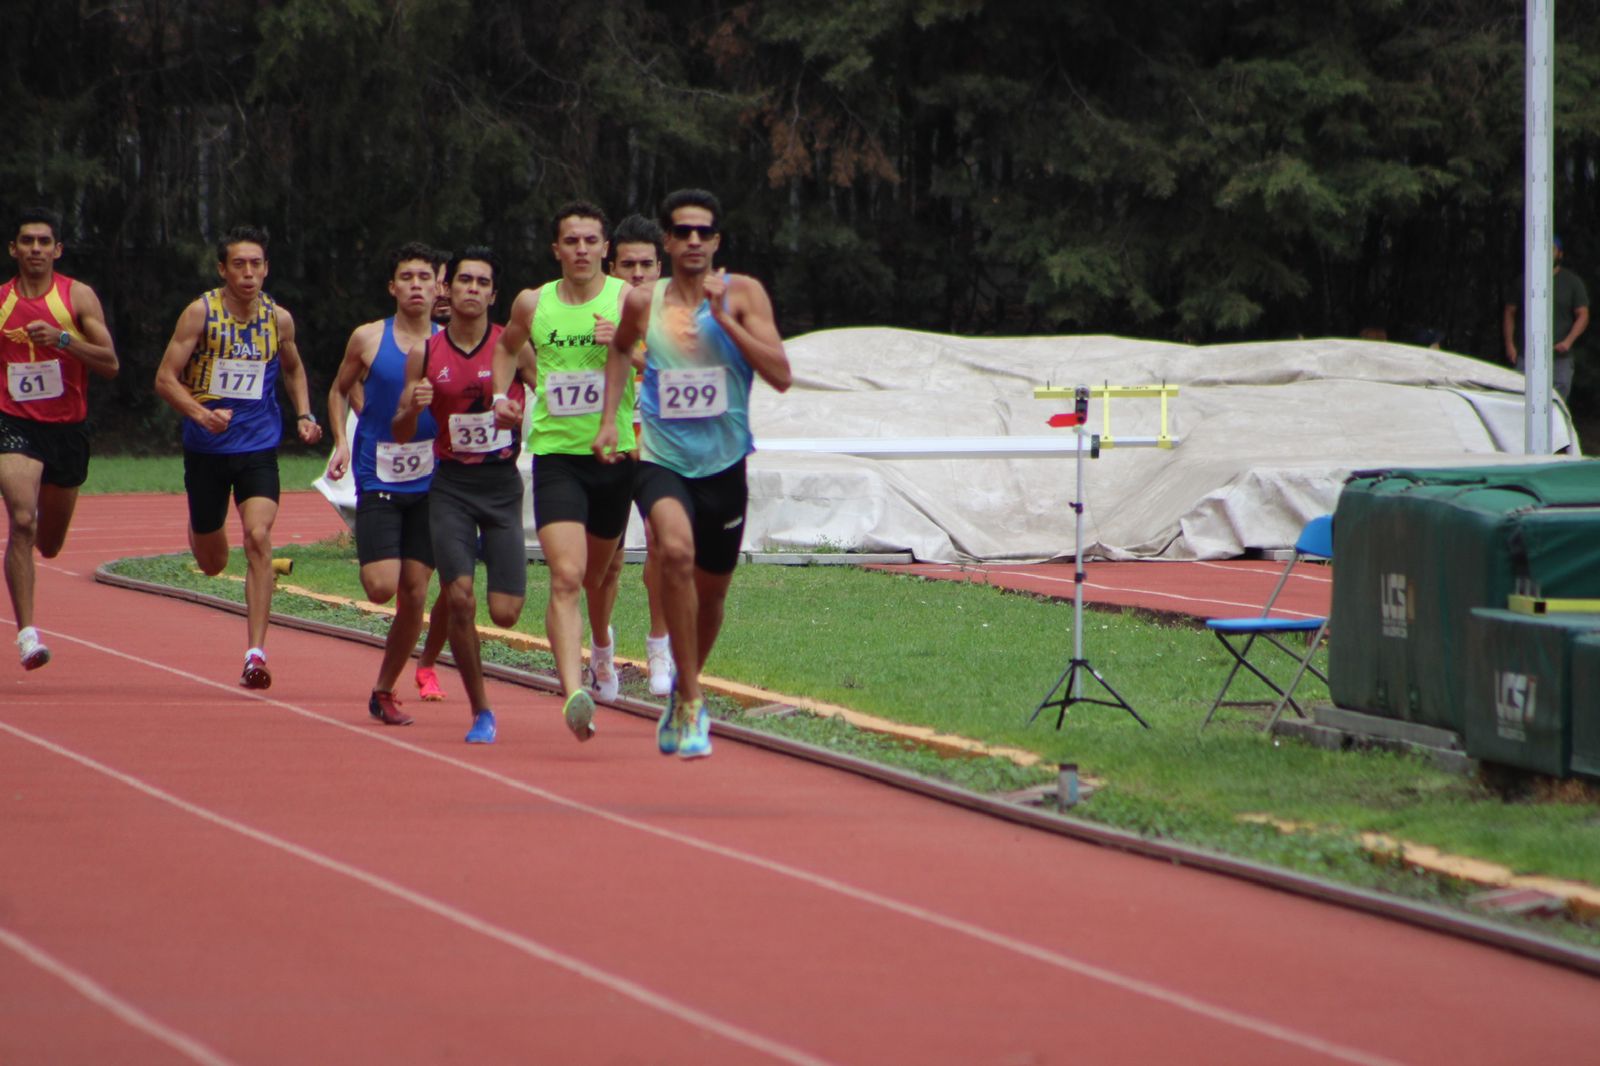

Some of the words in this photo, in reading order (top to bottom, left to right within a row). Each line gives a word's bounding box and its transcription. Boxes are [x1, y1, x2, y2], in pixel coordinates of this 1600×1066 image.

[232, 342, 262, 357] JAL
[19, 374, 45, 394] 61
[218, 371, 257, 391] 177
[552, 383, 600, 406] 176
[665, 384, 717, 408] 299
[391, 454, 421, 474] 59
